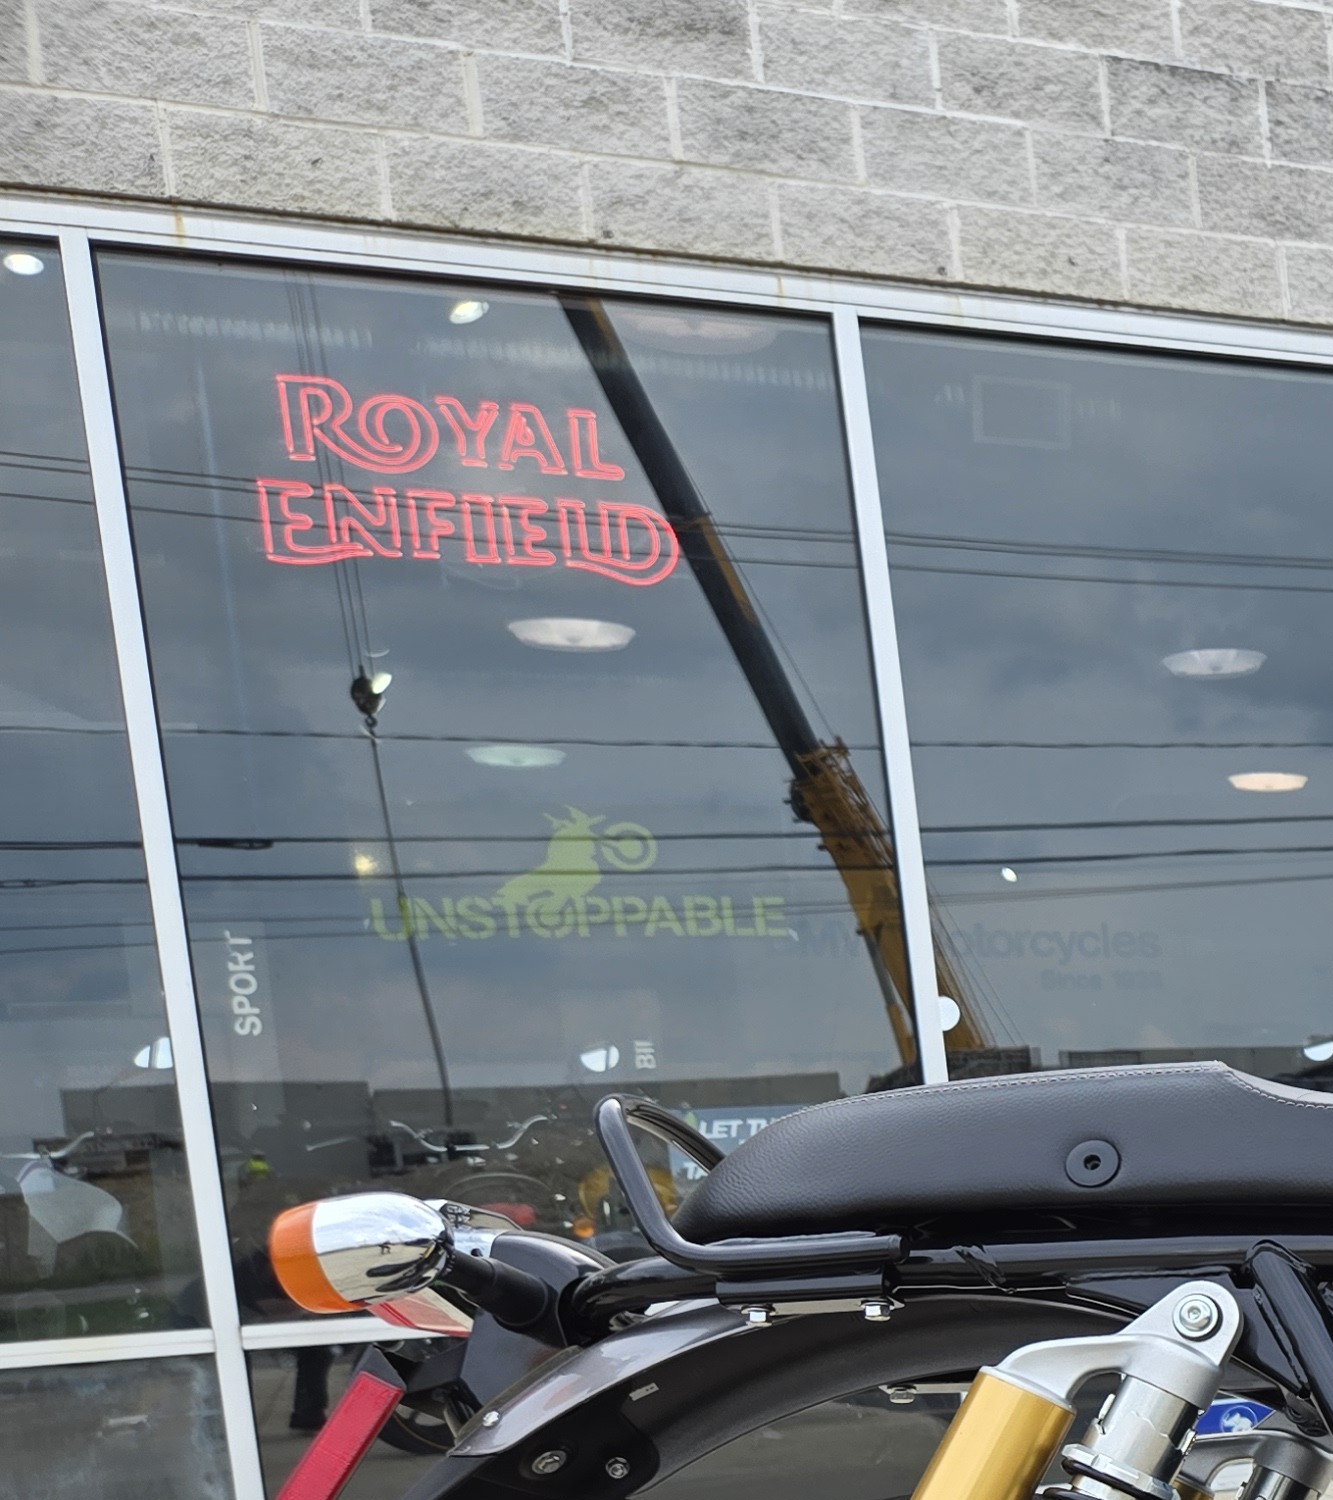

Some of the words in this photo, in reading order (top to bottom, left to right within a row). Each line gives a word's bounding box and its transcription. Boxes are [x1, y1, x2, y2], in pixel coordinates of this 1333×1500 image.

[276, 374, 625, 481] ROYAL
[257, 478, 680, 586] ENFIELD
[370, 893, 789, 941] UNSTOPPABLE
[225, 932, 263, 1037] SPORT
[699, 1119, 743, 1139] LET
